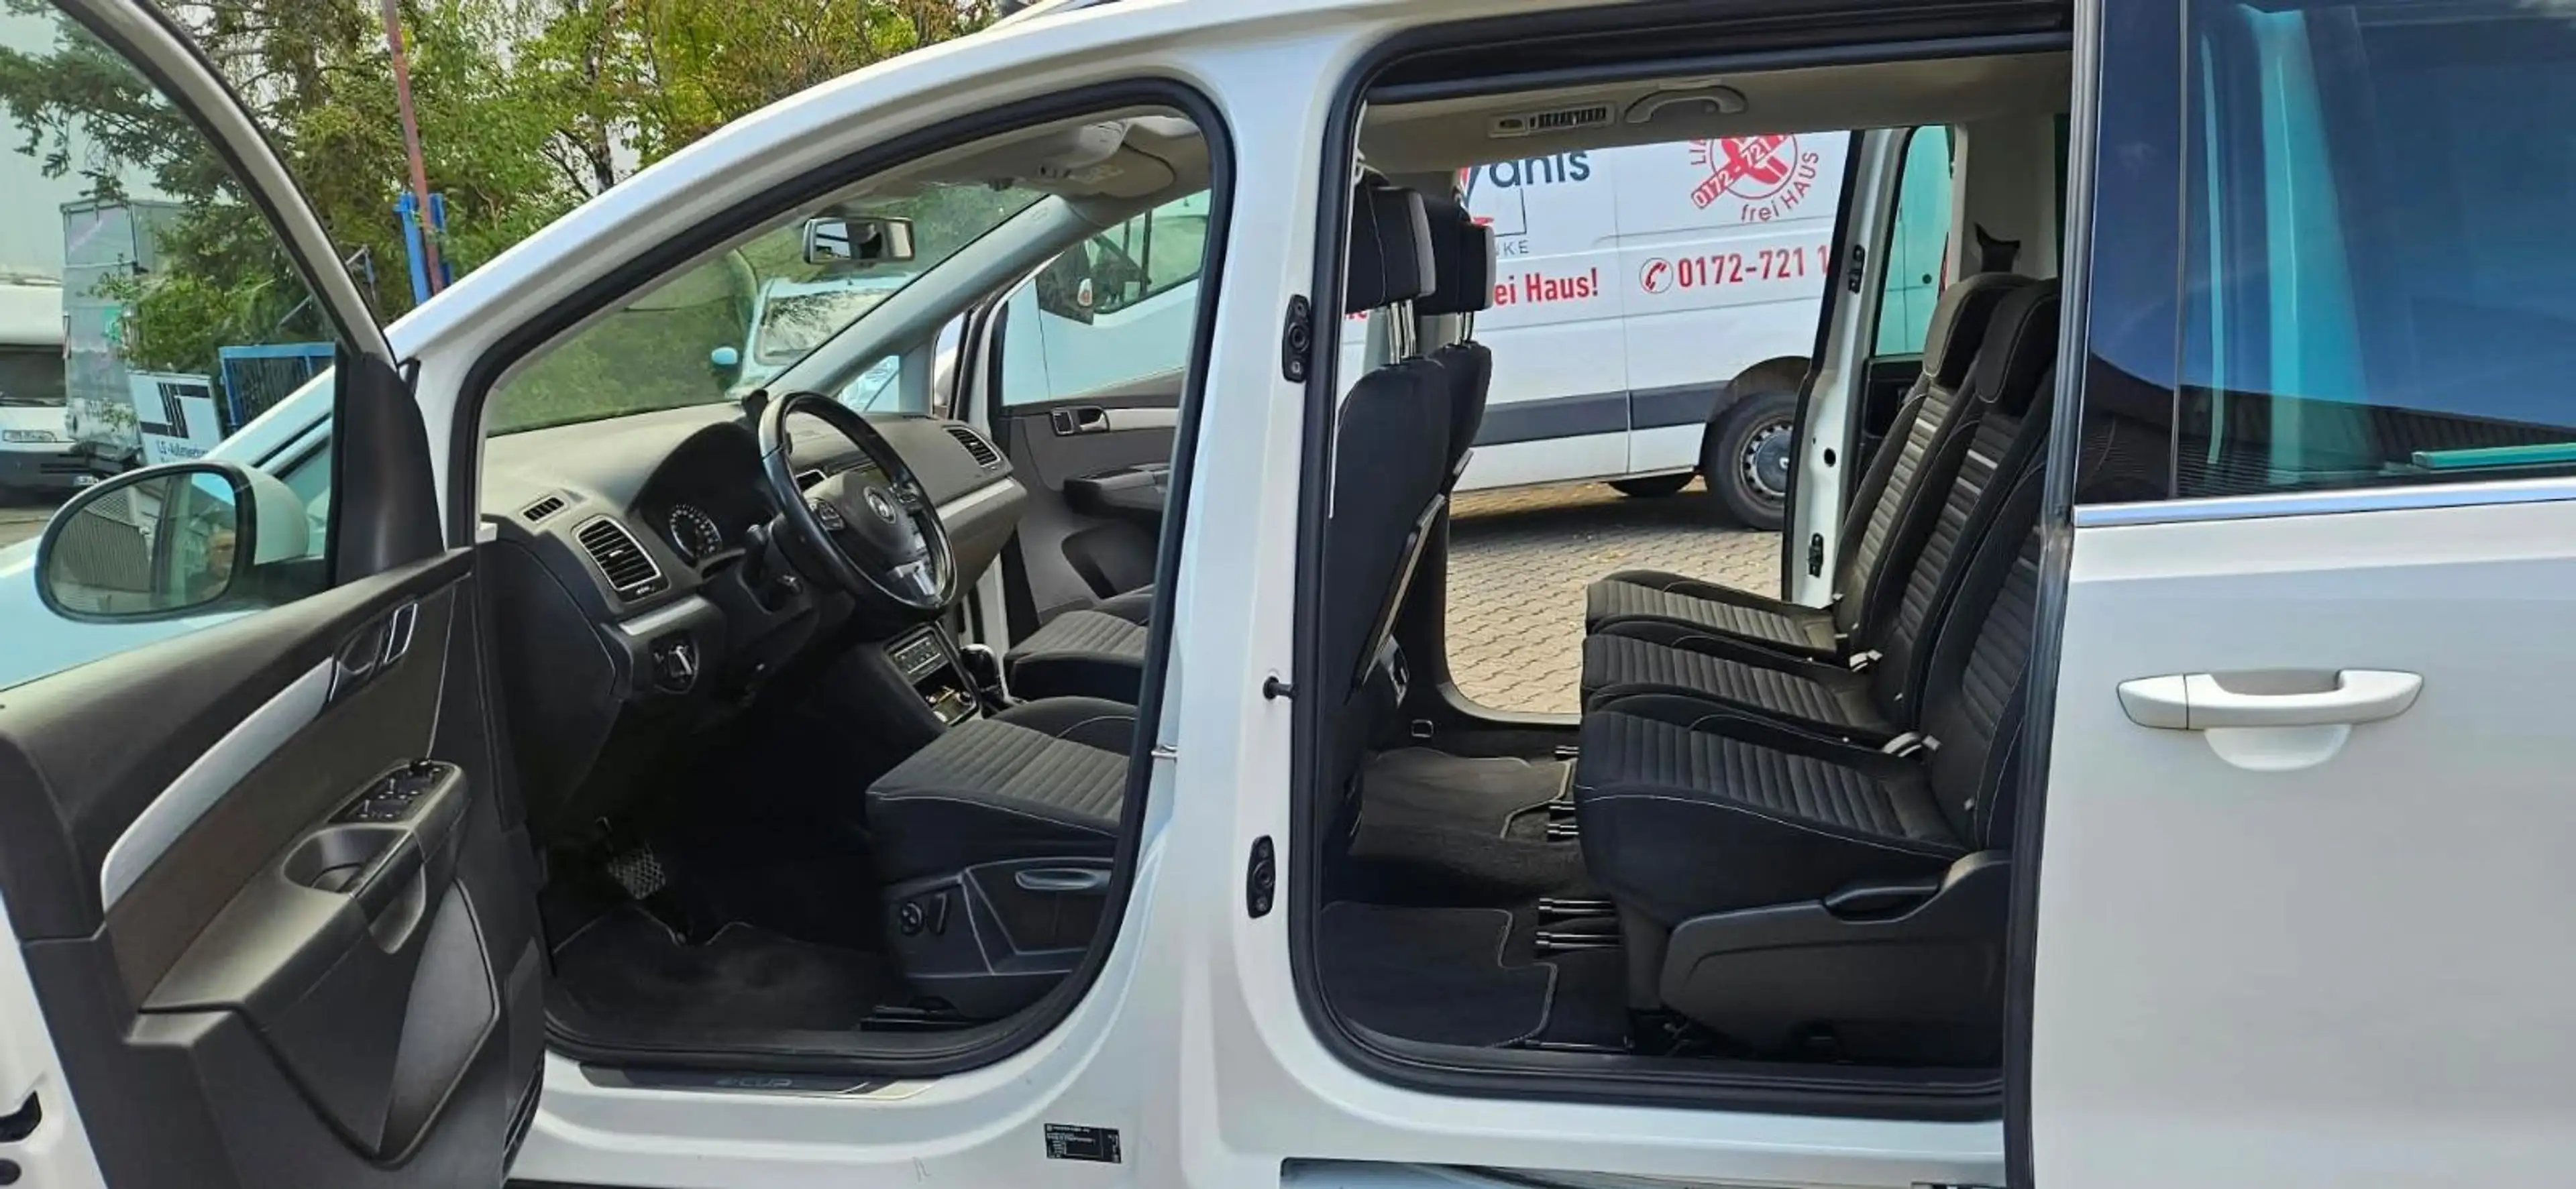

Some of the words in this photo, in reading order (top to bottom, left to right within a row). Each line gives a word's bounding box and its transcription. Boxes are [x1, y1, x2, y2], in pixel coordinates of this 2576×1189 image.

[1741, 201, 1780, 223] frei
[1780, 152, 1819, 210] HAUS
[1496, 239, 1529, 256] KE
[1494, 274, 1516, 305] ei
[1525, 267, 1598, 303] Haus!
[1678, 247, 1805, 288] 0172-721
